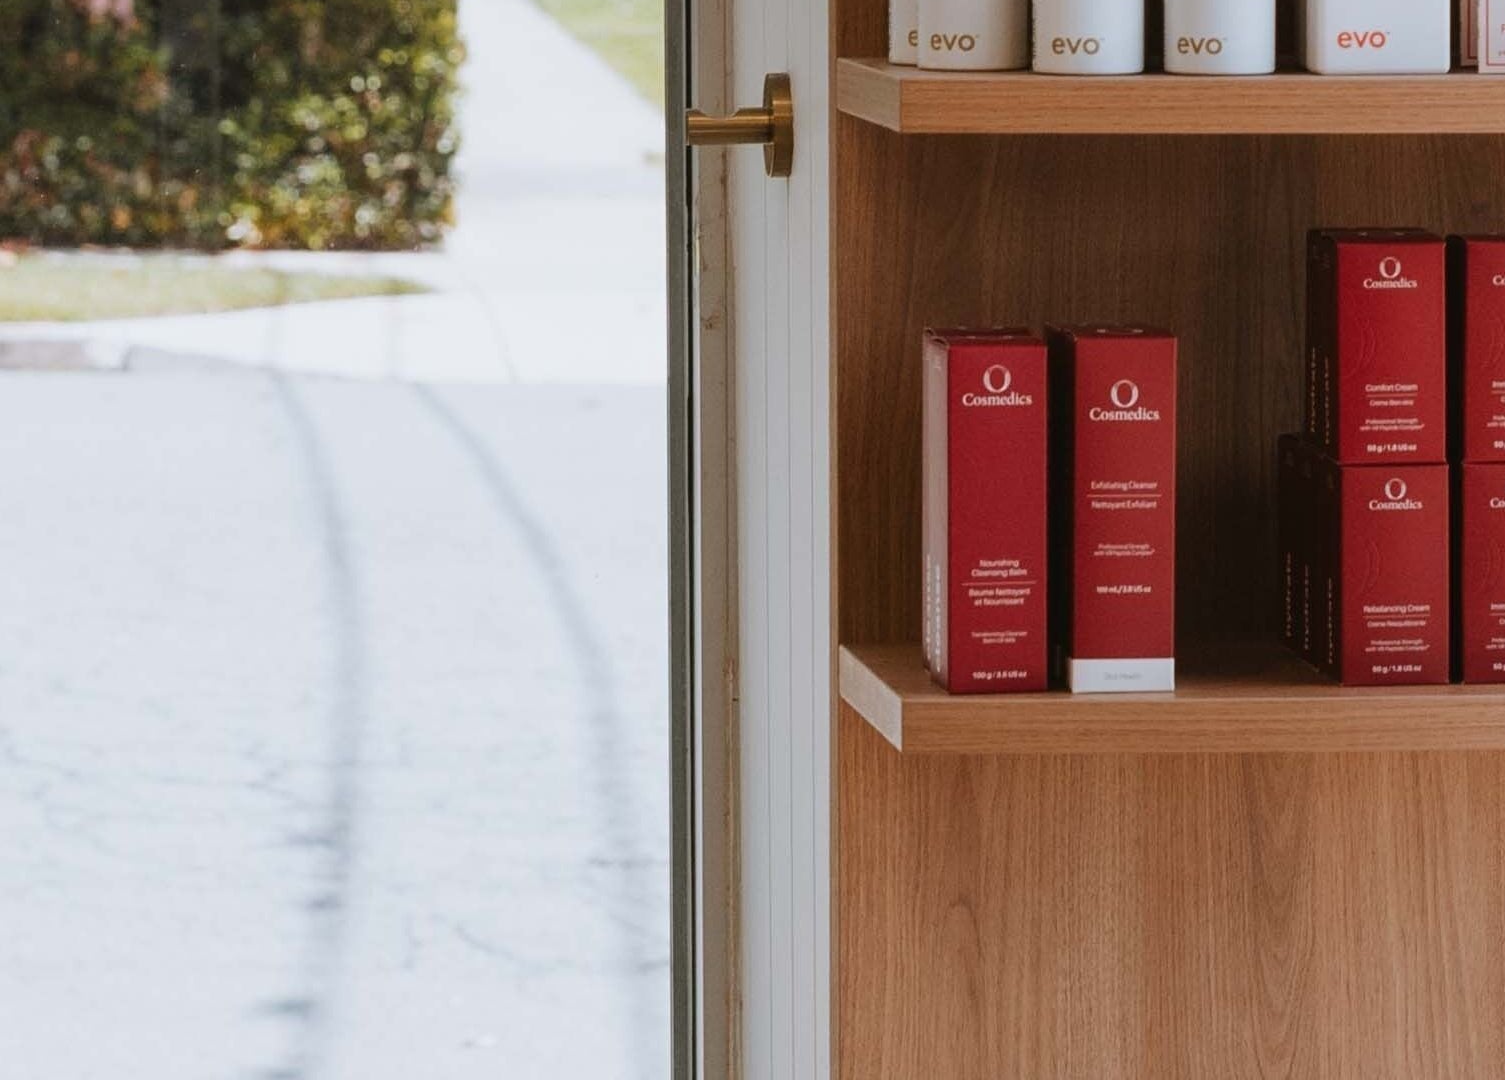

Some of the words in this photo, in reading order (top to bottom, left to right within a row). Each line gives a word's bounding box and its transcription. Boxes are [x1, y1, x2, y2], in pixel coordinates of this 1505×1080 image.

[930, 34, 975, 52] evo
[1051, 37, 1100, 55] evo
[1177, 37, 1223, 55] evo
[1337, 31, 1386, 49] evo
[1363, 277, 1418, 288] Cosmedics
[962, 391, 1032, 406] Cosmedics
[1089, 407, 1160, 421] Cosmedics
[1369, 499, 1423, 510] Cosmedics
